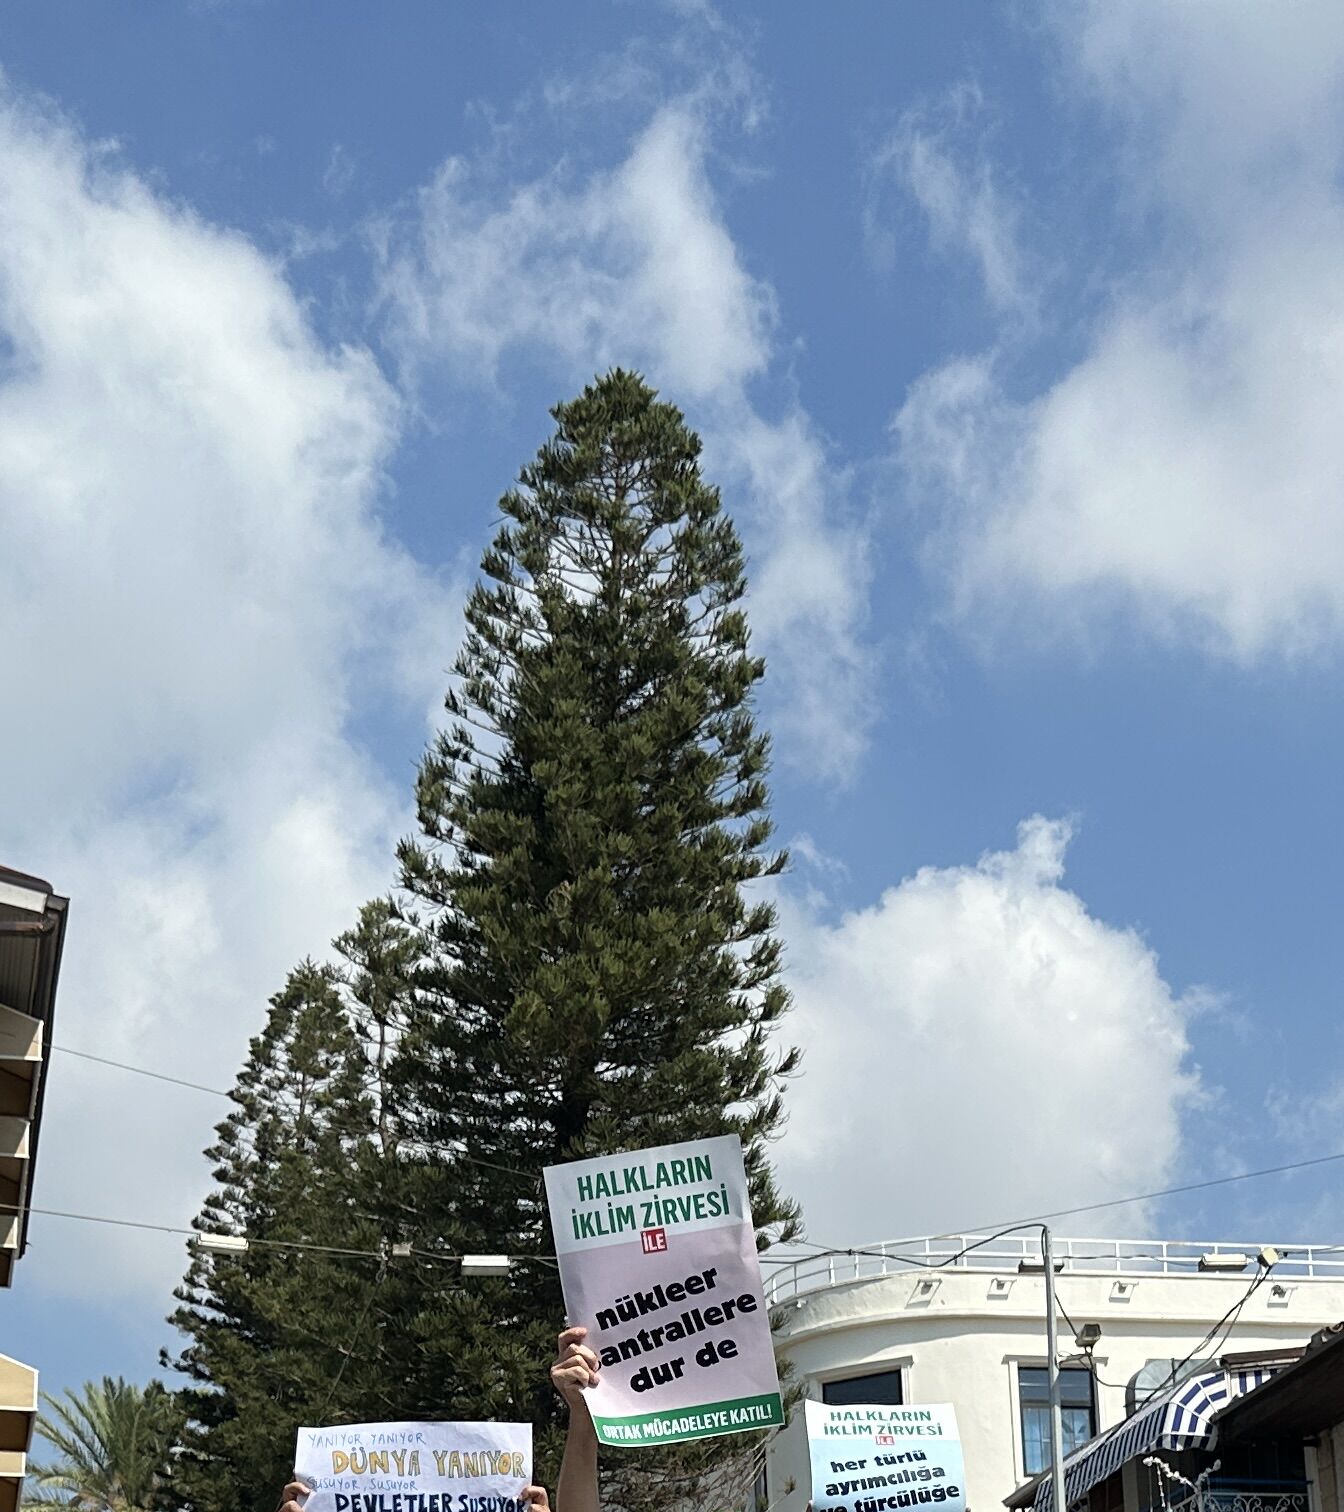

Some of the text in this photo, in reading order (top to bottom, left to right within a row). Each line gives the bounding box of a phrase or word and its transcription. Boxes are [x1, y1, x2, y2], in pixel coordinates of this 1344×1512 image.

[577, 1155, 713, 1202] HALKLARIN
[571, 1184, 730, 1240] İKLİM ZİRVESİ
[596, 1268, 718, 1330] nükleer
[594, 1293, 757, 1370] antrallere
[630, 1339, 739, 1393] dur de
[824, 1423, 942, 1435] İKLİM ZİRVESİ
[830, 1411, 932, 1422] HALKLARIN
[370, 1432, 426, 1446] YANIYOR
[332, 1446, 526, 1479] DÜNYA YANIYOR
[831, 1450, 927, 1472] her türlü
[826, 1466, 945, 1496] ayrımcılığa
